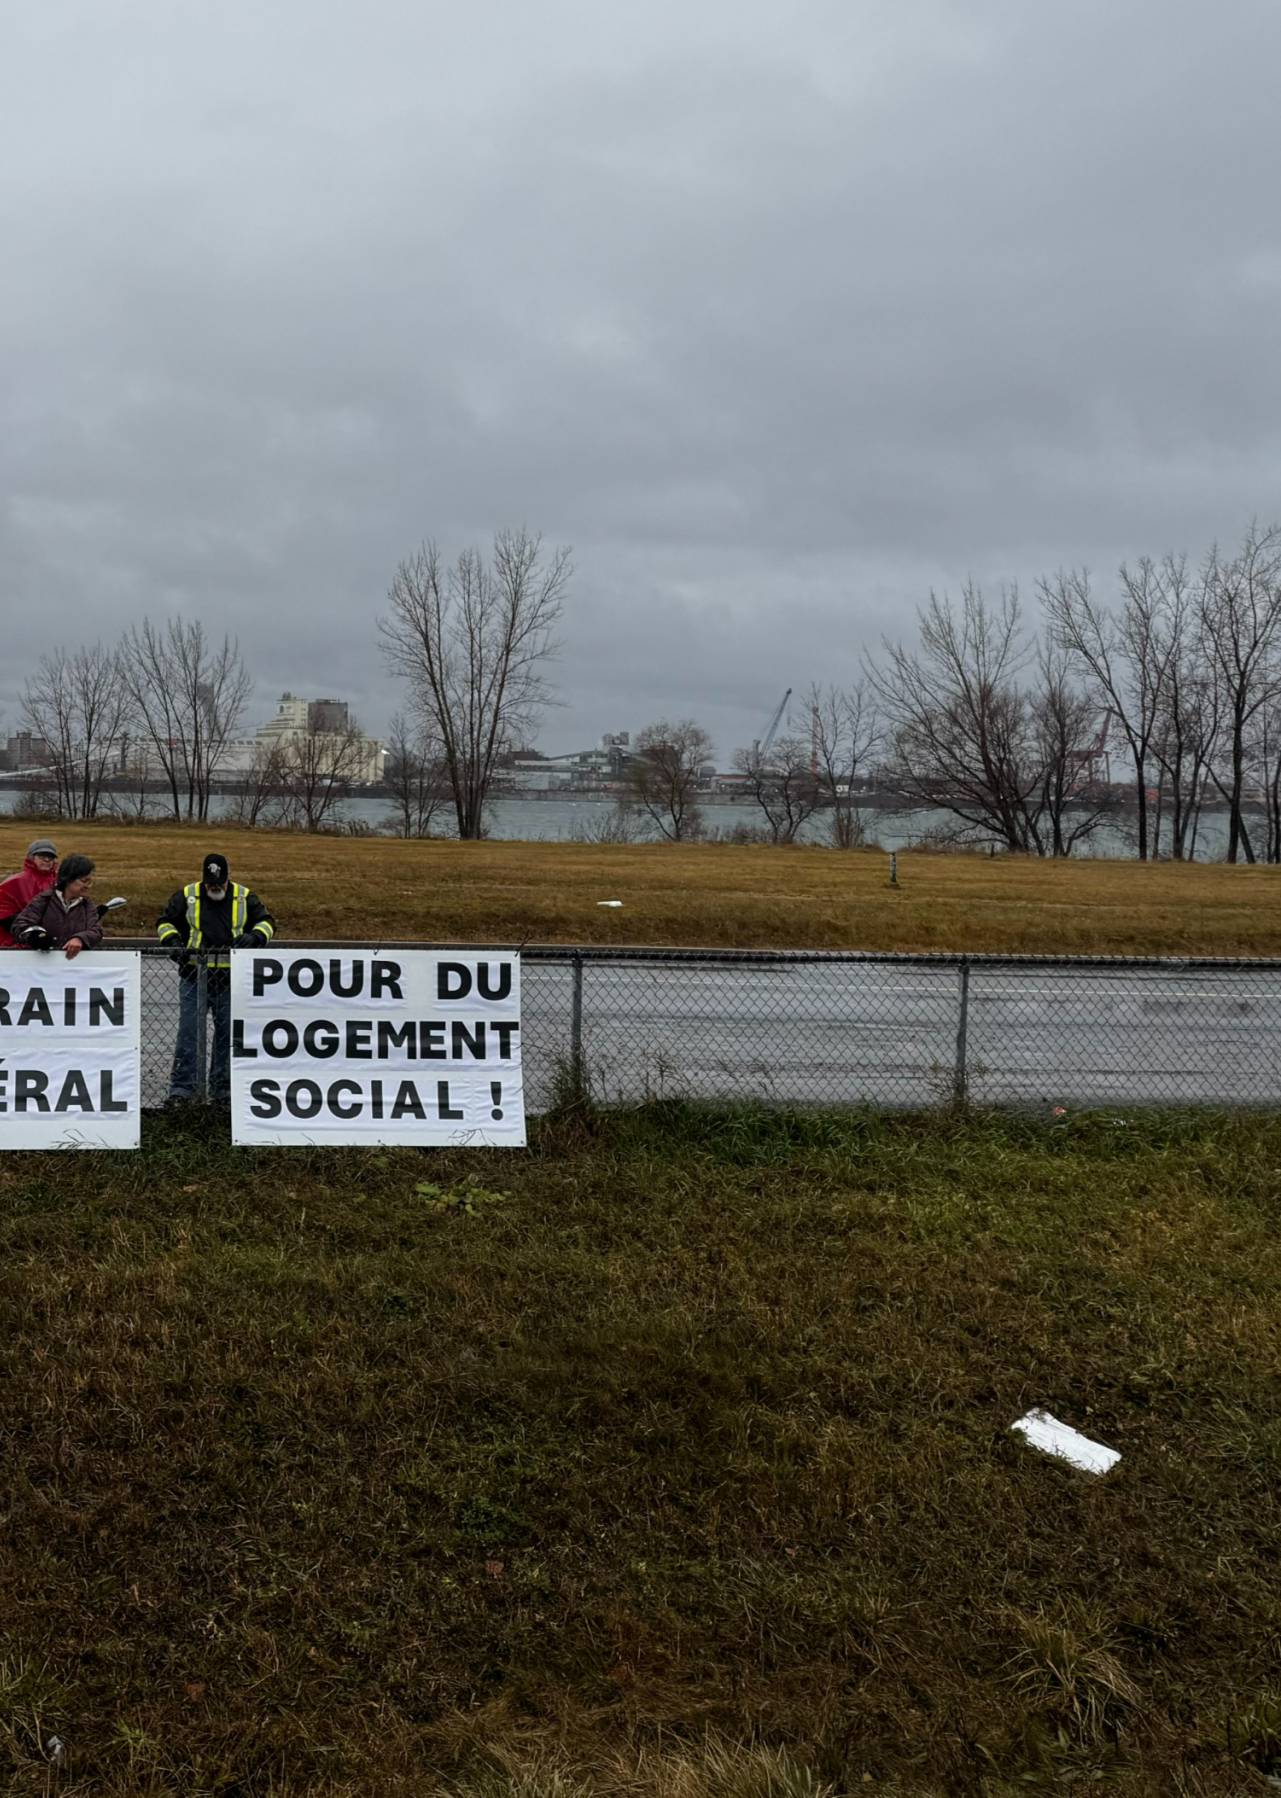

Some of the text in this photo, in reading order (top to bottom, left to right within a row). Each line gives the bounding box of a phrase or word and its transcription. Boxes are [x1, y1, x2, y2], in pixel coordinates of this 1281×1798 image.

[252, 958, 512, 1001] POUR DU
[232, 1019, 519, 1060] LOGEMENT
[250, 1078, 504, 1121] SOCIAL !
